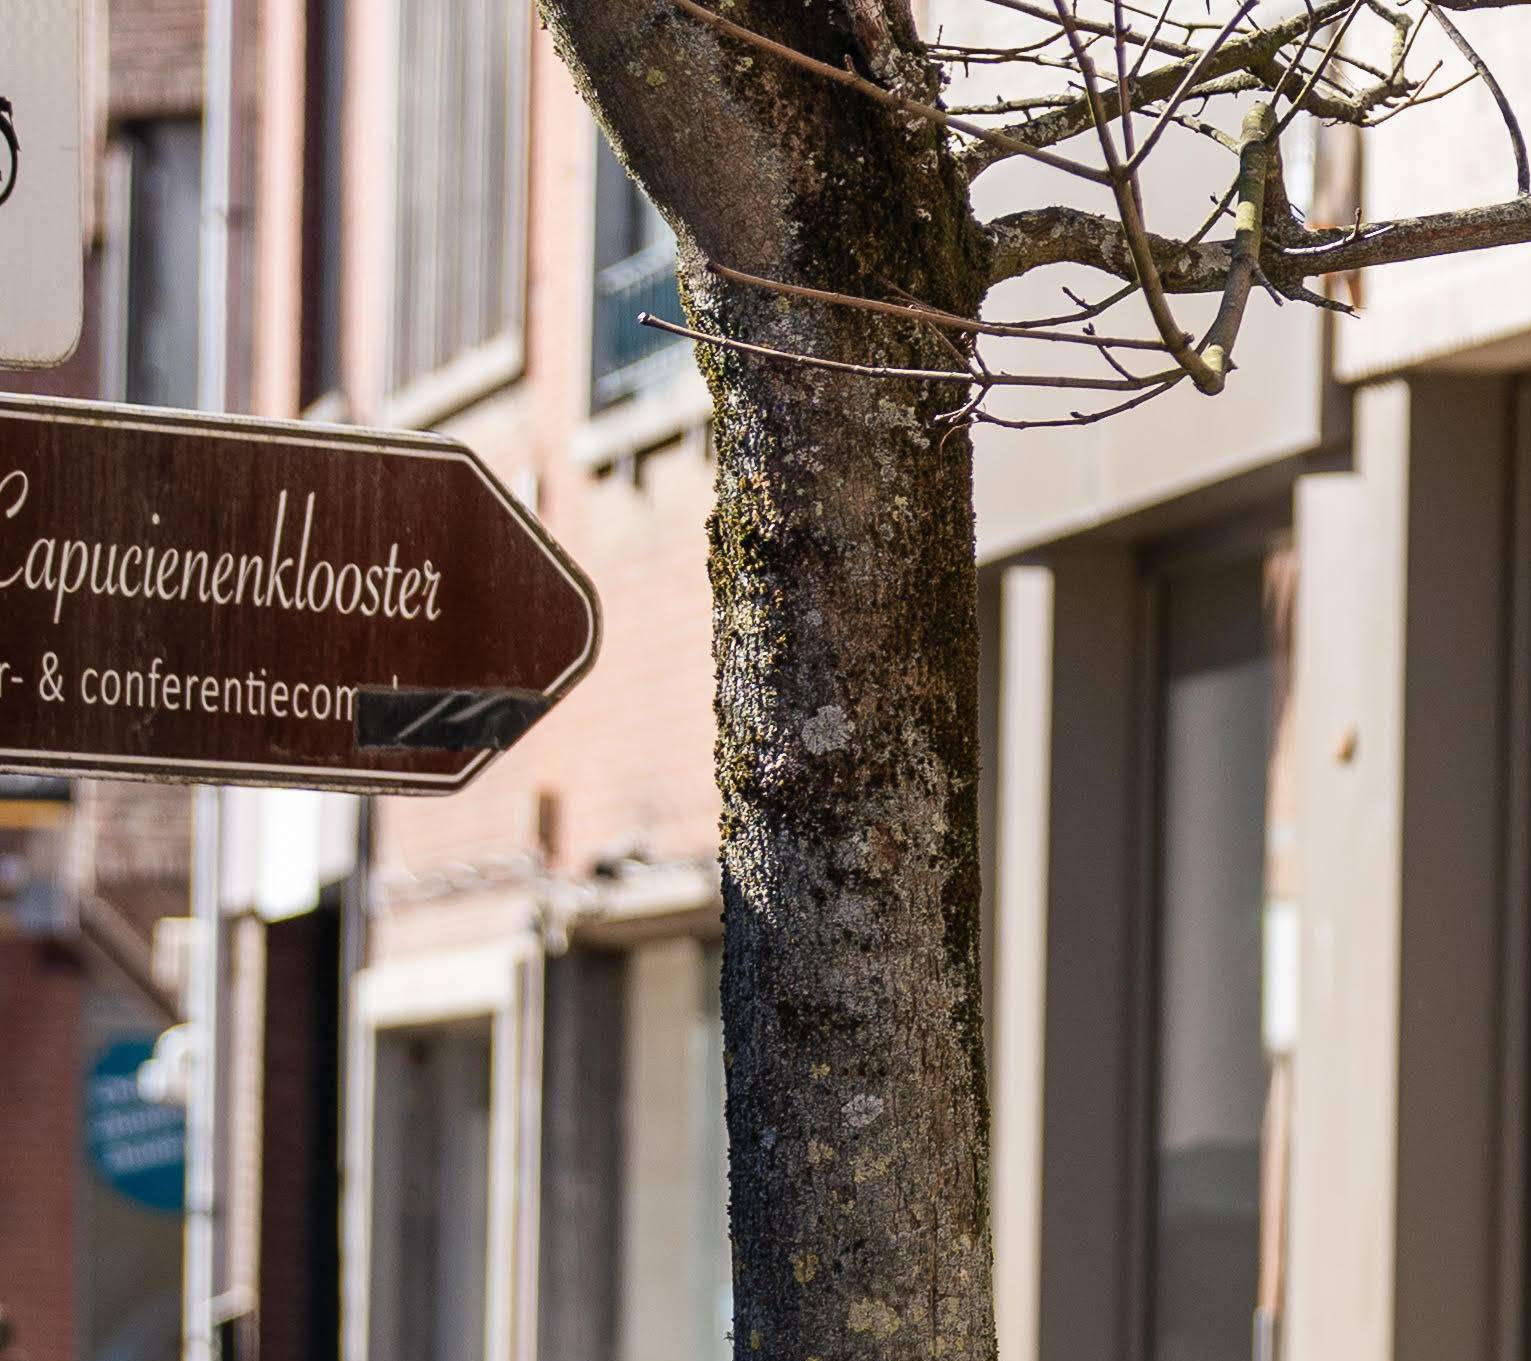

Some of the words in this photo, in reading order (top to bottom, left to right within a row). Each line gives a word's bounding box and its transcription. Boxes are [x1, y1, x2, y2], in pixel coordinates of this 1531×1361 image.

[0, 470, 441, 624] Capucienenklooster
[39, 651, 65, 703] &
[81, 657, 398, 721] conferentiecom
